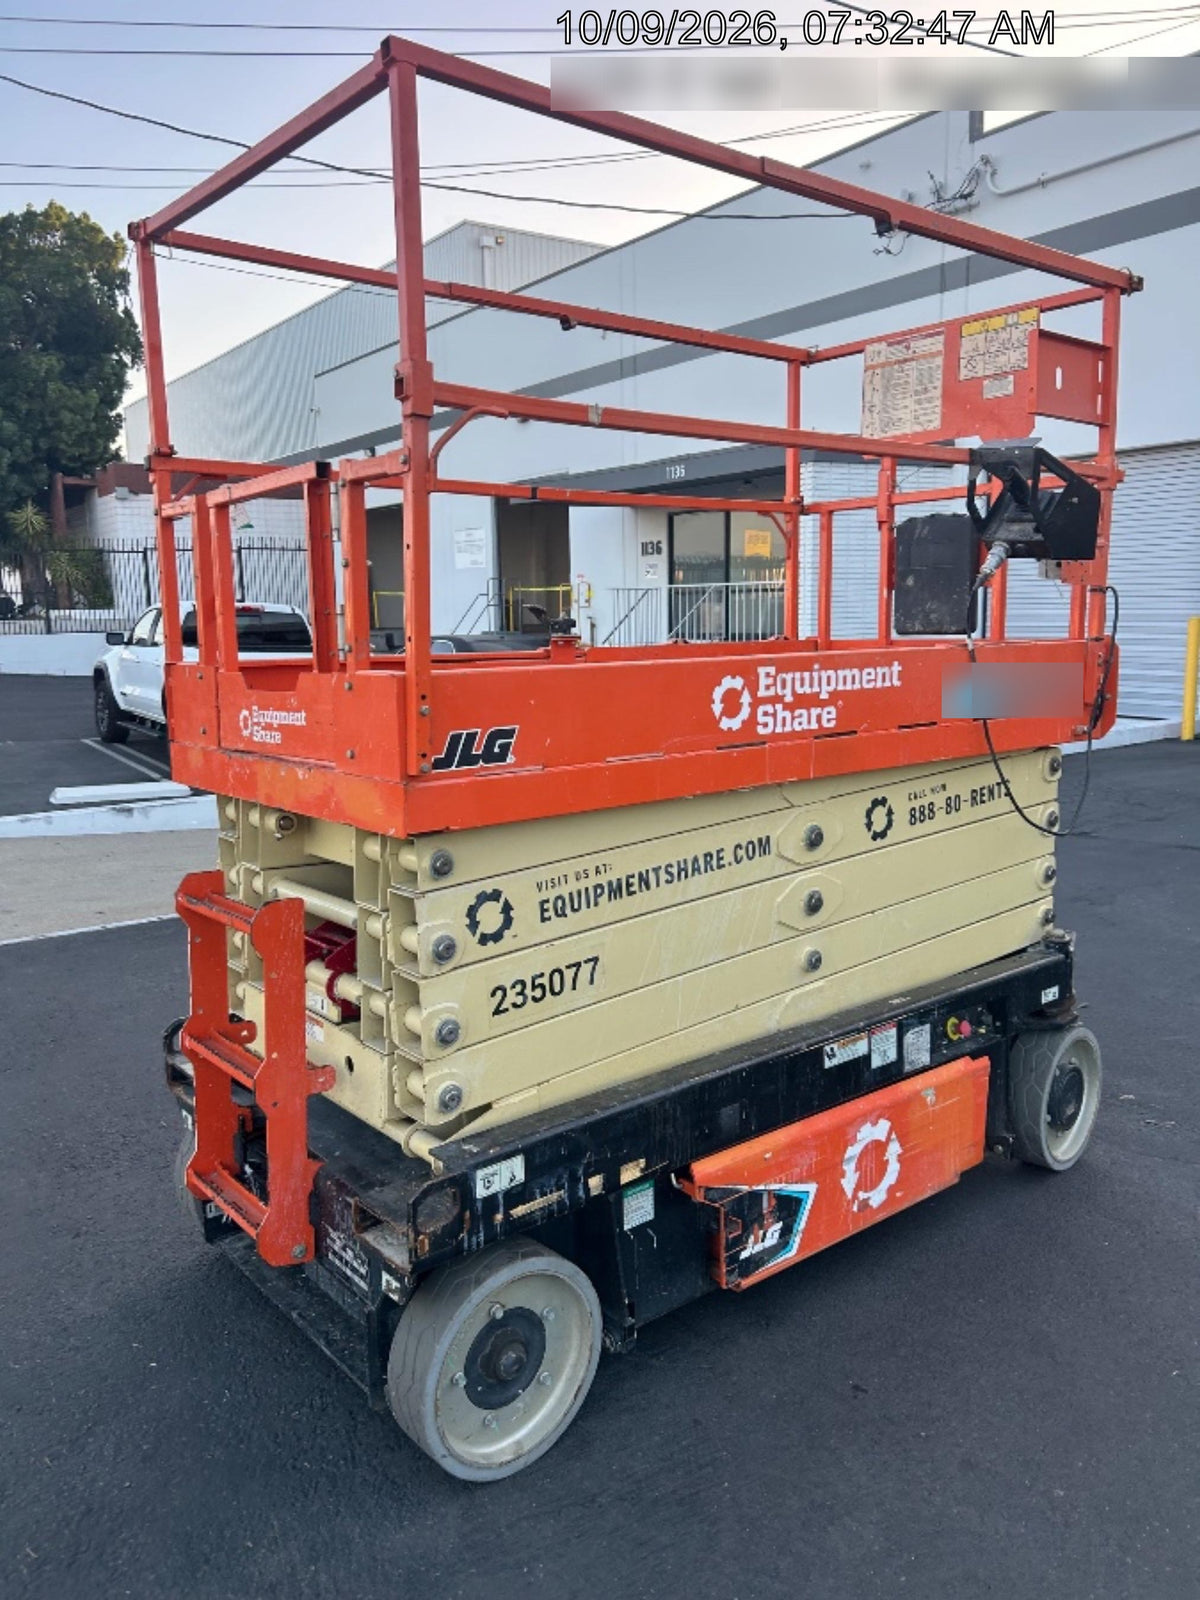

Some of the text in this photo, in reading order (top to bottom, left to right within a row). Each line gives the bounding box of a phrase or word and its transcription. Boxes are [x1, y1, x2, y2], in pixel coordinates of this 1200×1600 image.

[641, 540, 662, 556] 1136
[757, 661, 902, 702] Equipment
[252, 706, 306, 728] Equipment
[757, 703, 837, 735] Share
[432, 725, 519, 773] JLG
[536, 863, 613, 893] VISIT US AT:
[538, 835, 771, 923] EQUIPMENTSHARE.COM
[490, 955, 599, 1017] 235077
